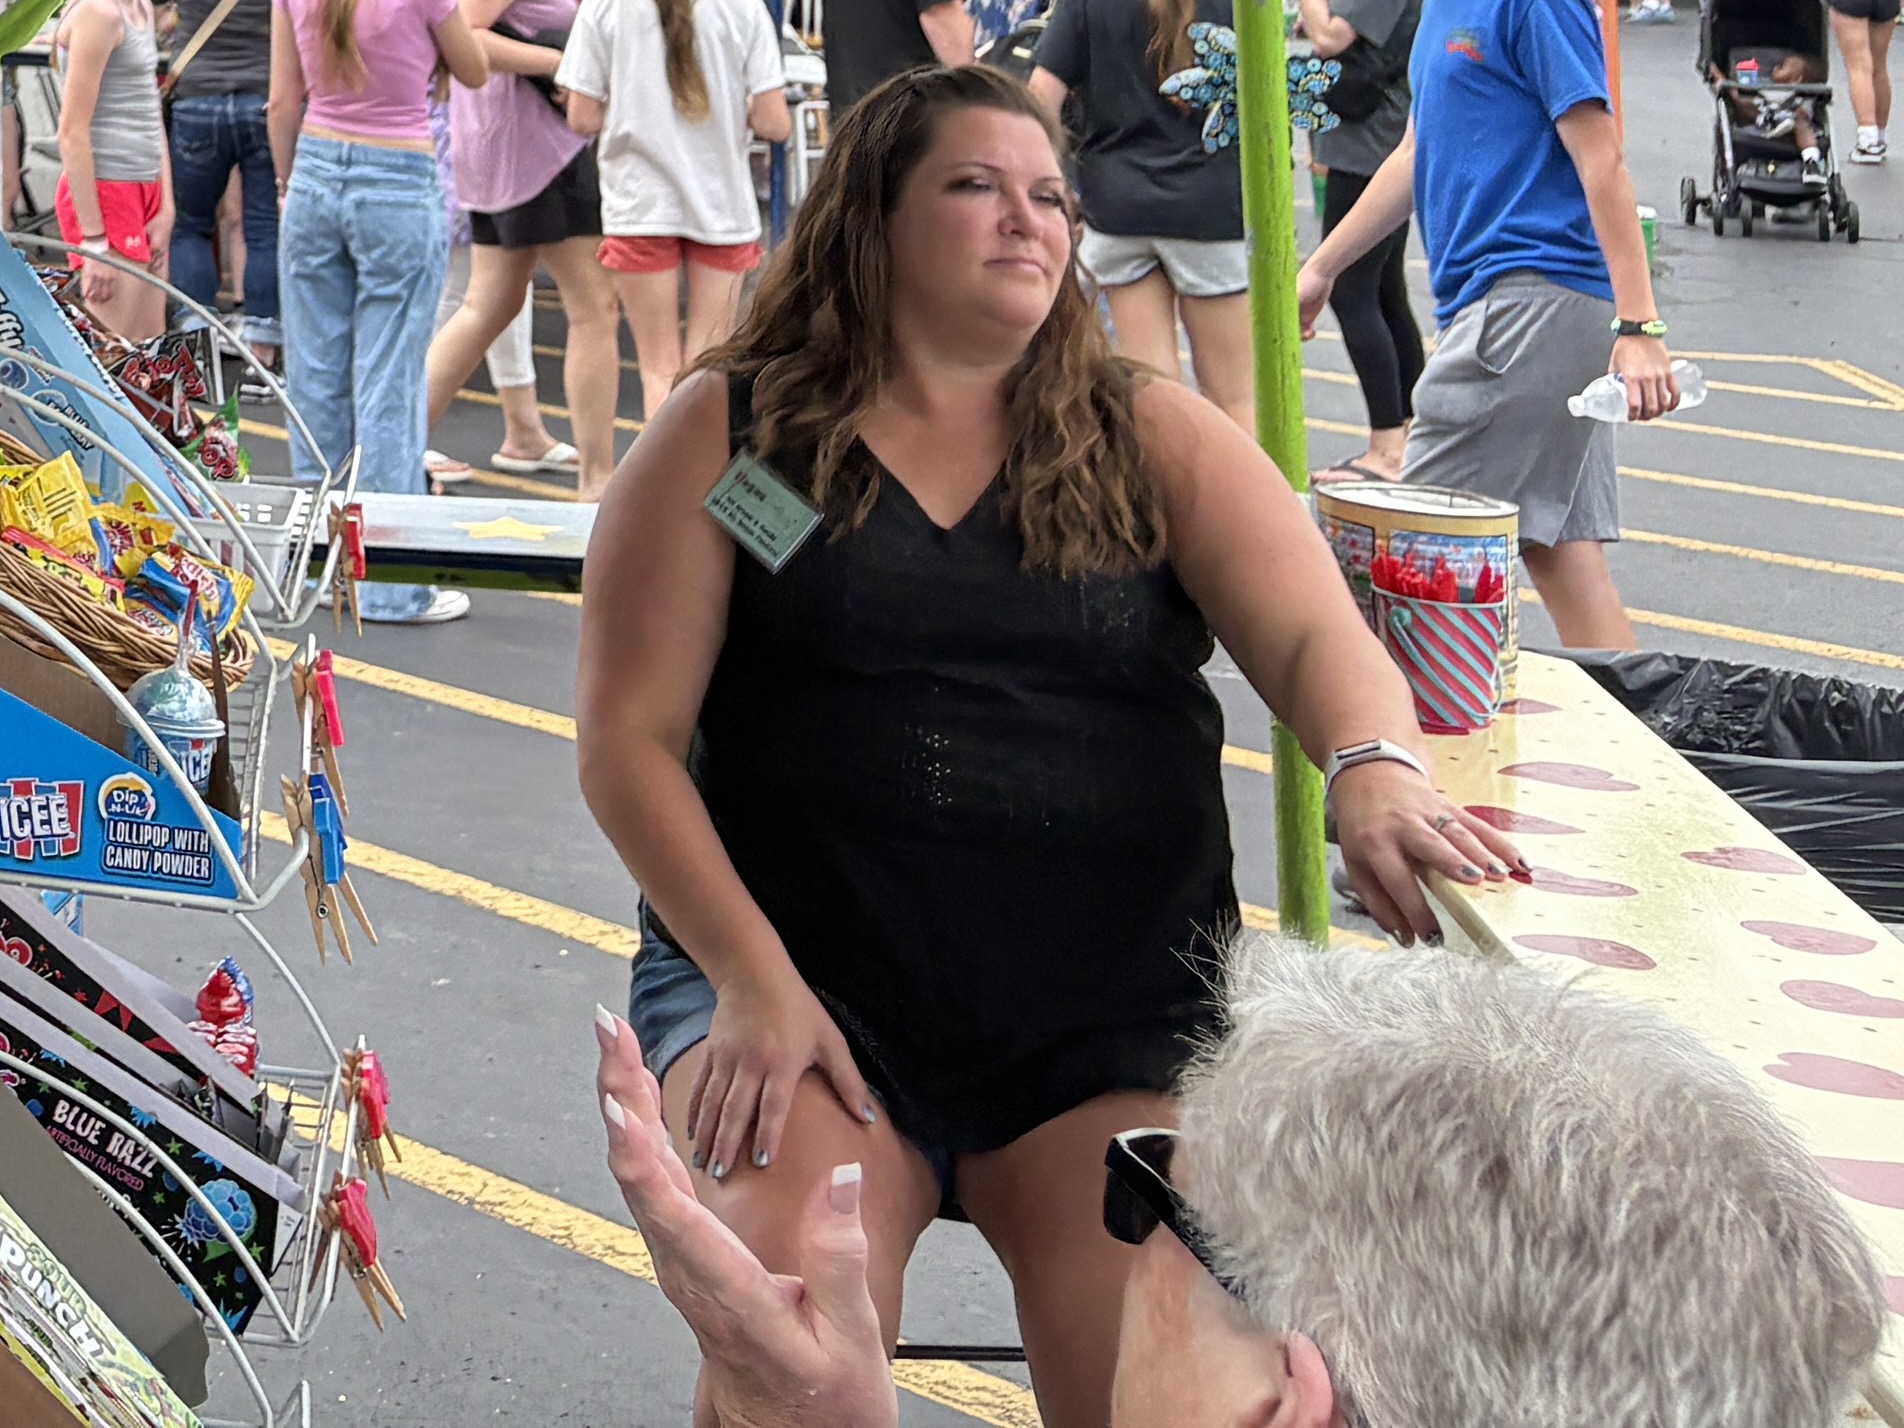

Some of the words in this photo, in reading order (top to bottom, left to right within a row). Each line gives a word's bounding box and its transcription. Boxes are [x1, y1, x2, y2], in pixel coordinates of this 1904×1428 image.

[105, 847, 151, 872] CANDY
[153, 853, 210, 879] POWDER
[108, 820, 169, 848] LOLLIPOP
[173, 828, 209, 853] WITH
[52, 1099, 106, 1145] BLUE
[106, 1132, 159, 1178] RAZZ
[27, 1243, 86, 1318] SOUR
